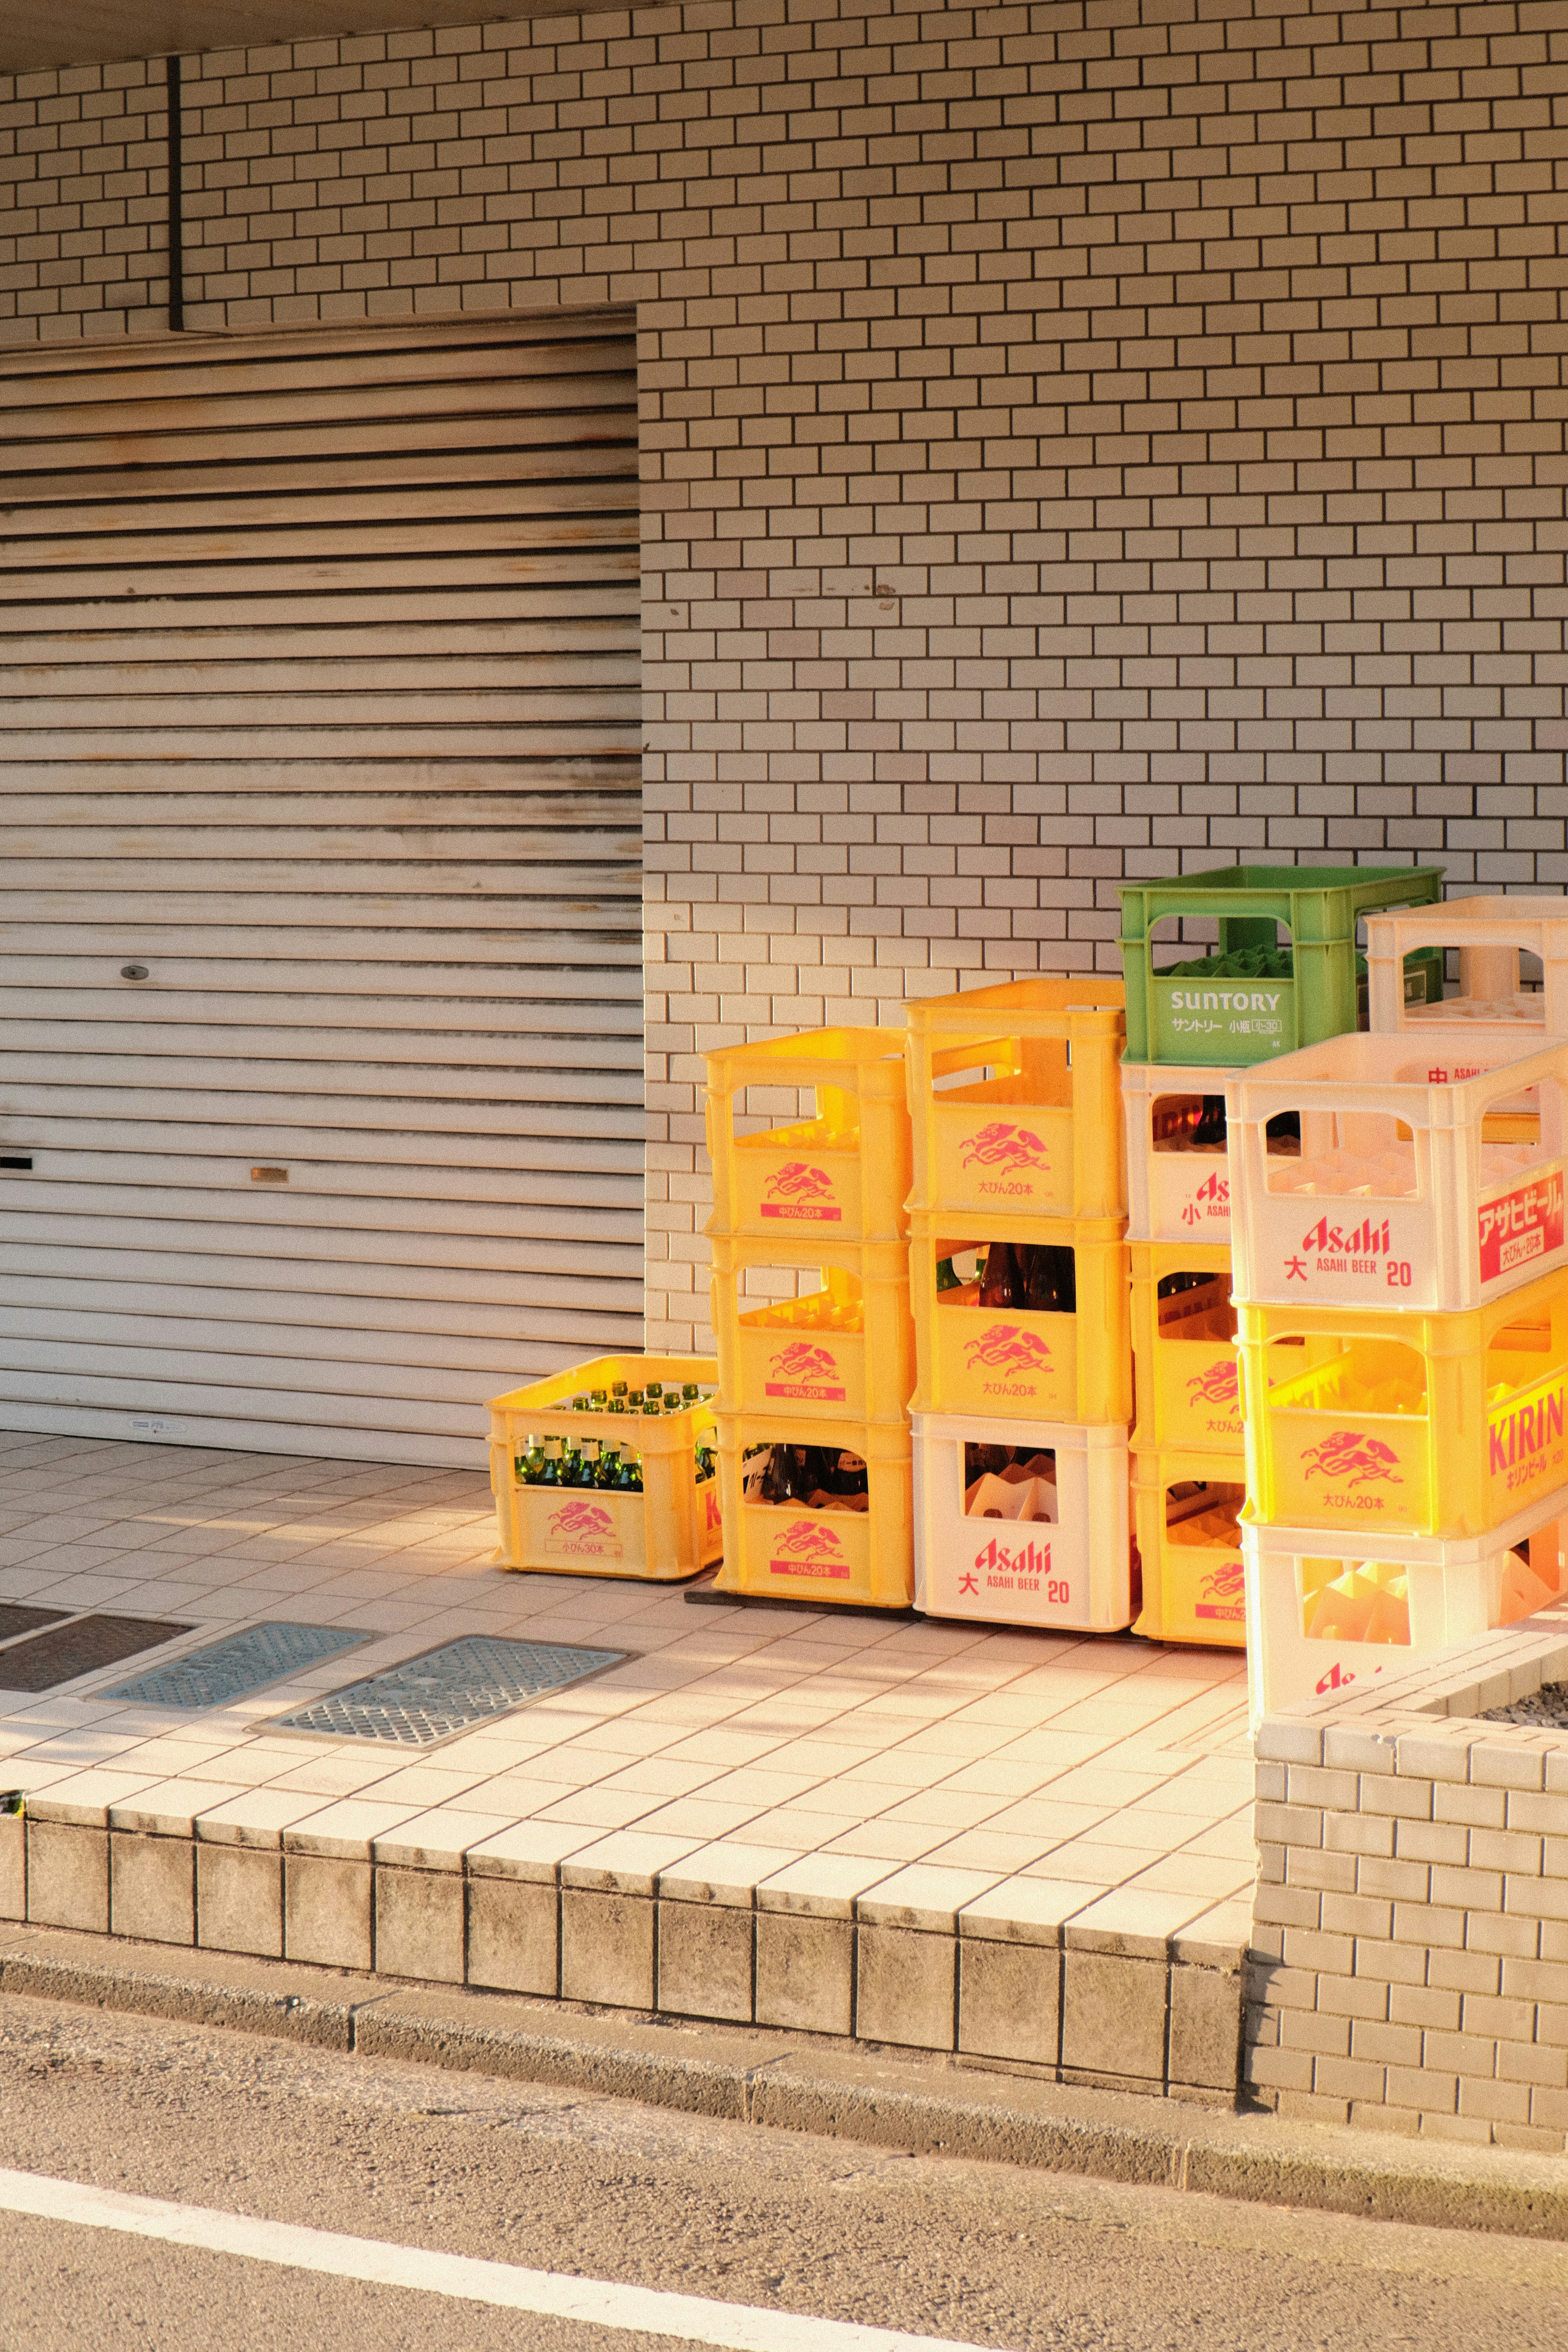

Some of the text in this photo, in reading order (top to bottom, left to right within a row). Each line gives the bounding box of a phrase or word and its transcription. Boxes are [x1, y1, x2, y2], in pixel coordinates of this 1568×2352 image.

[1172, 1018, 1222, 1033] サントリー
[978, 1181, 1033, 1196] 大びん20本
[1181, 1203, 1201, 1225] 小
[1479, 1180, 1563, 1246] アサヒビール
[1302, 1216, 1390, 1255] Asahi
[1284, 1255, 1411, 1287] 大 ASAHI BEER 20
[983, 1382, 1037, 1397] 大びん20本
[1490, 1386, 1563, 1476] KIRIN
[1323, 1494, 1385, 1510] 大びん20本
[975, 1538, 1051, 1575] Asahi
[958, 1572, 1069, 1603] 大 ASAHI BEER 20
